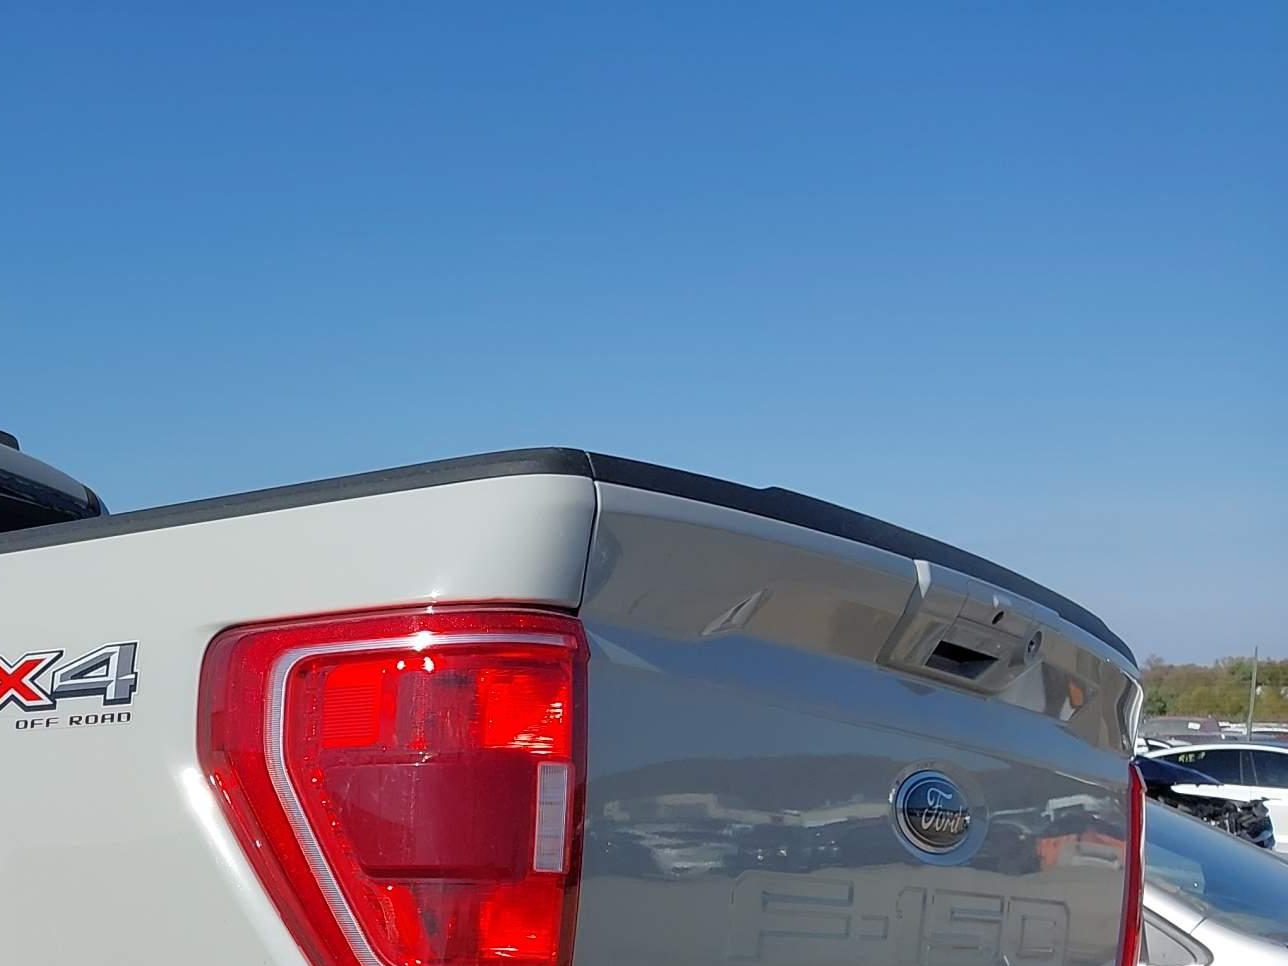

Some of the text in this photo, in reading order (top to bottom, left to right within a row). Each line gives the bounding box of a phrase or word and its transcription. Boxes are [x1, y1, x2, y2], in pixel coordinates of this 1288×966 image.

[15, 711, 132, 730] OFF ROAD
[921, 787, 965, 834] Ford
